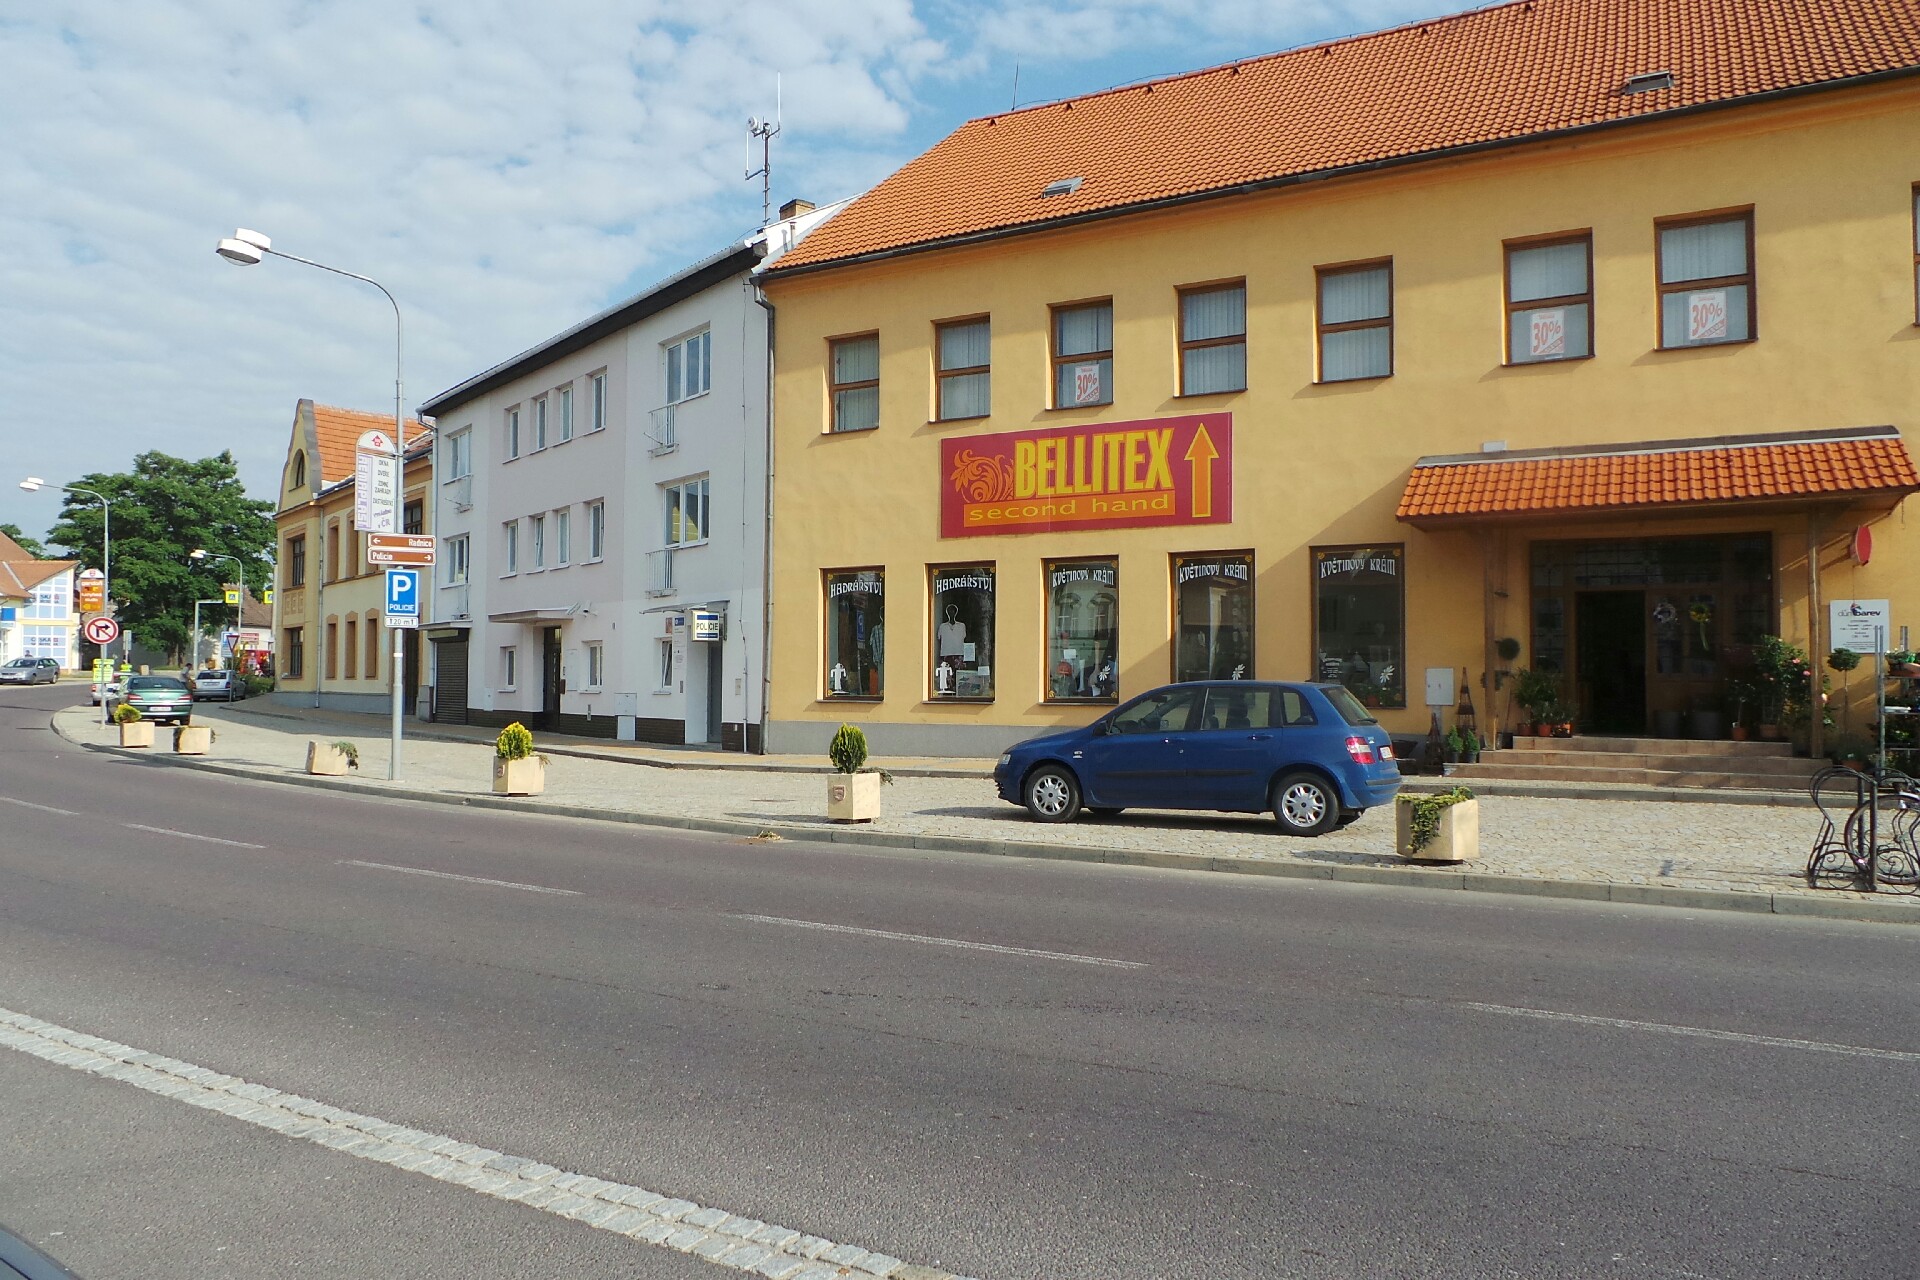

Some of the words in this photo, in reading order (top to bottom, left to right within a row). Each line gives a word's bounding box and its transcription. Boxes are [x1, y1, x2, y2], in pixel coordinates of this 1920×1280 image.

[1692, 302, 1722, 336] 30%
[1533, 320, 1561, 353] 30%
[1077, 373, 1097, 400] 30%
[1013, 428, 1175, 499] BELLITEX
[969, 500, 1076, 521] second
[1092, 494, 1169, 512] hand
[408, 538, 432, 547] Radnice
[372, 551, 393, 560] Policie
[1370, 555, 1396, 576] KRÁM
[1093, 567, 1114, 585] KRÁM
[1224, 561, 1248, 581] KRÁM
[392, 575, 412, 601] P
[830, 578, 882, 598] HADRÁŘSTVÍ
[936, 574, 993, 594] HADRÁŘSTVÍ
[389, 604, 415, 612] POLICIE
[696, 622, 719, 631] POLICIE
